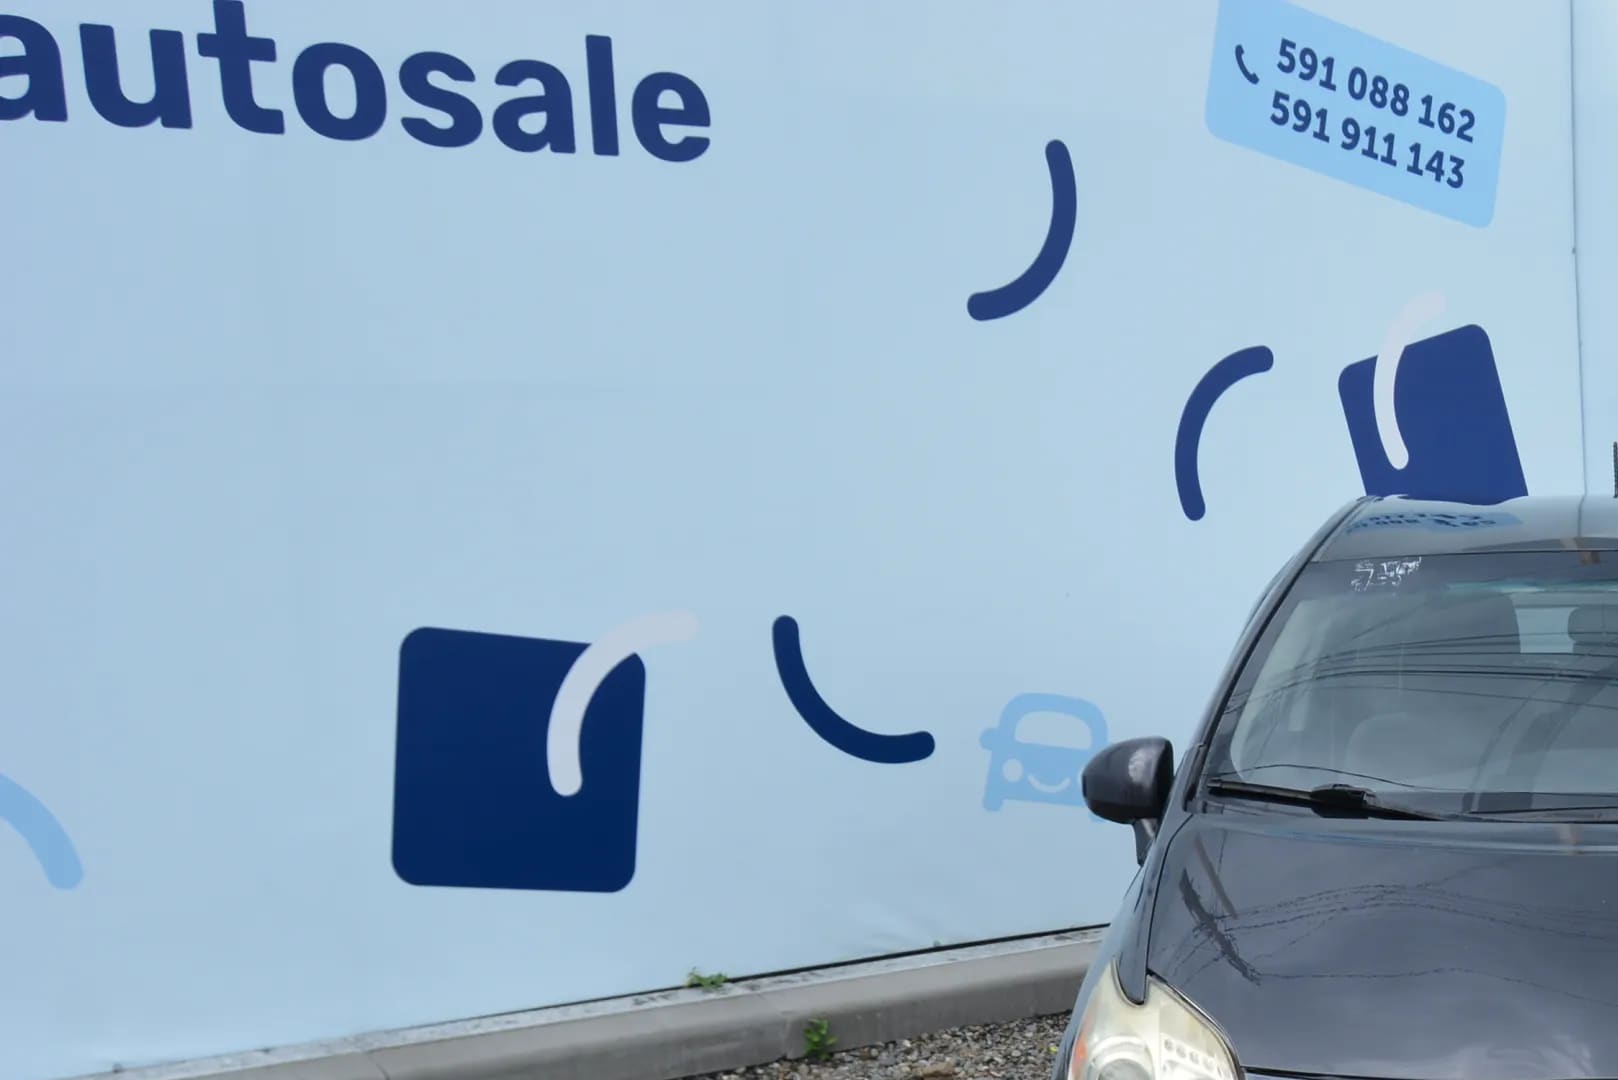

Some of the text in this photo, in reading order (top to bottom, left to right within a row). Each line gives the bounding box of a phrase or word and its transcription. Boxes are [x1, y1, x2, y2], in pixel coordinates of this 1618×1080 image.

[0, 0, 712, 163] autosale
[1276, 38, 1476, 143] 591 088 162
[1270, 90, 1465, 189] 591 911 143
